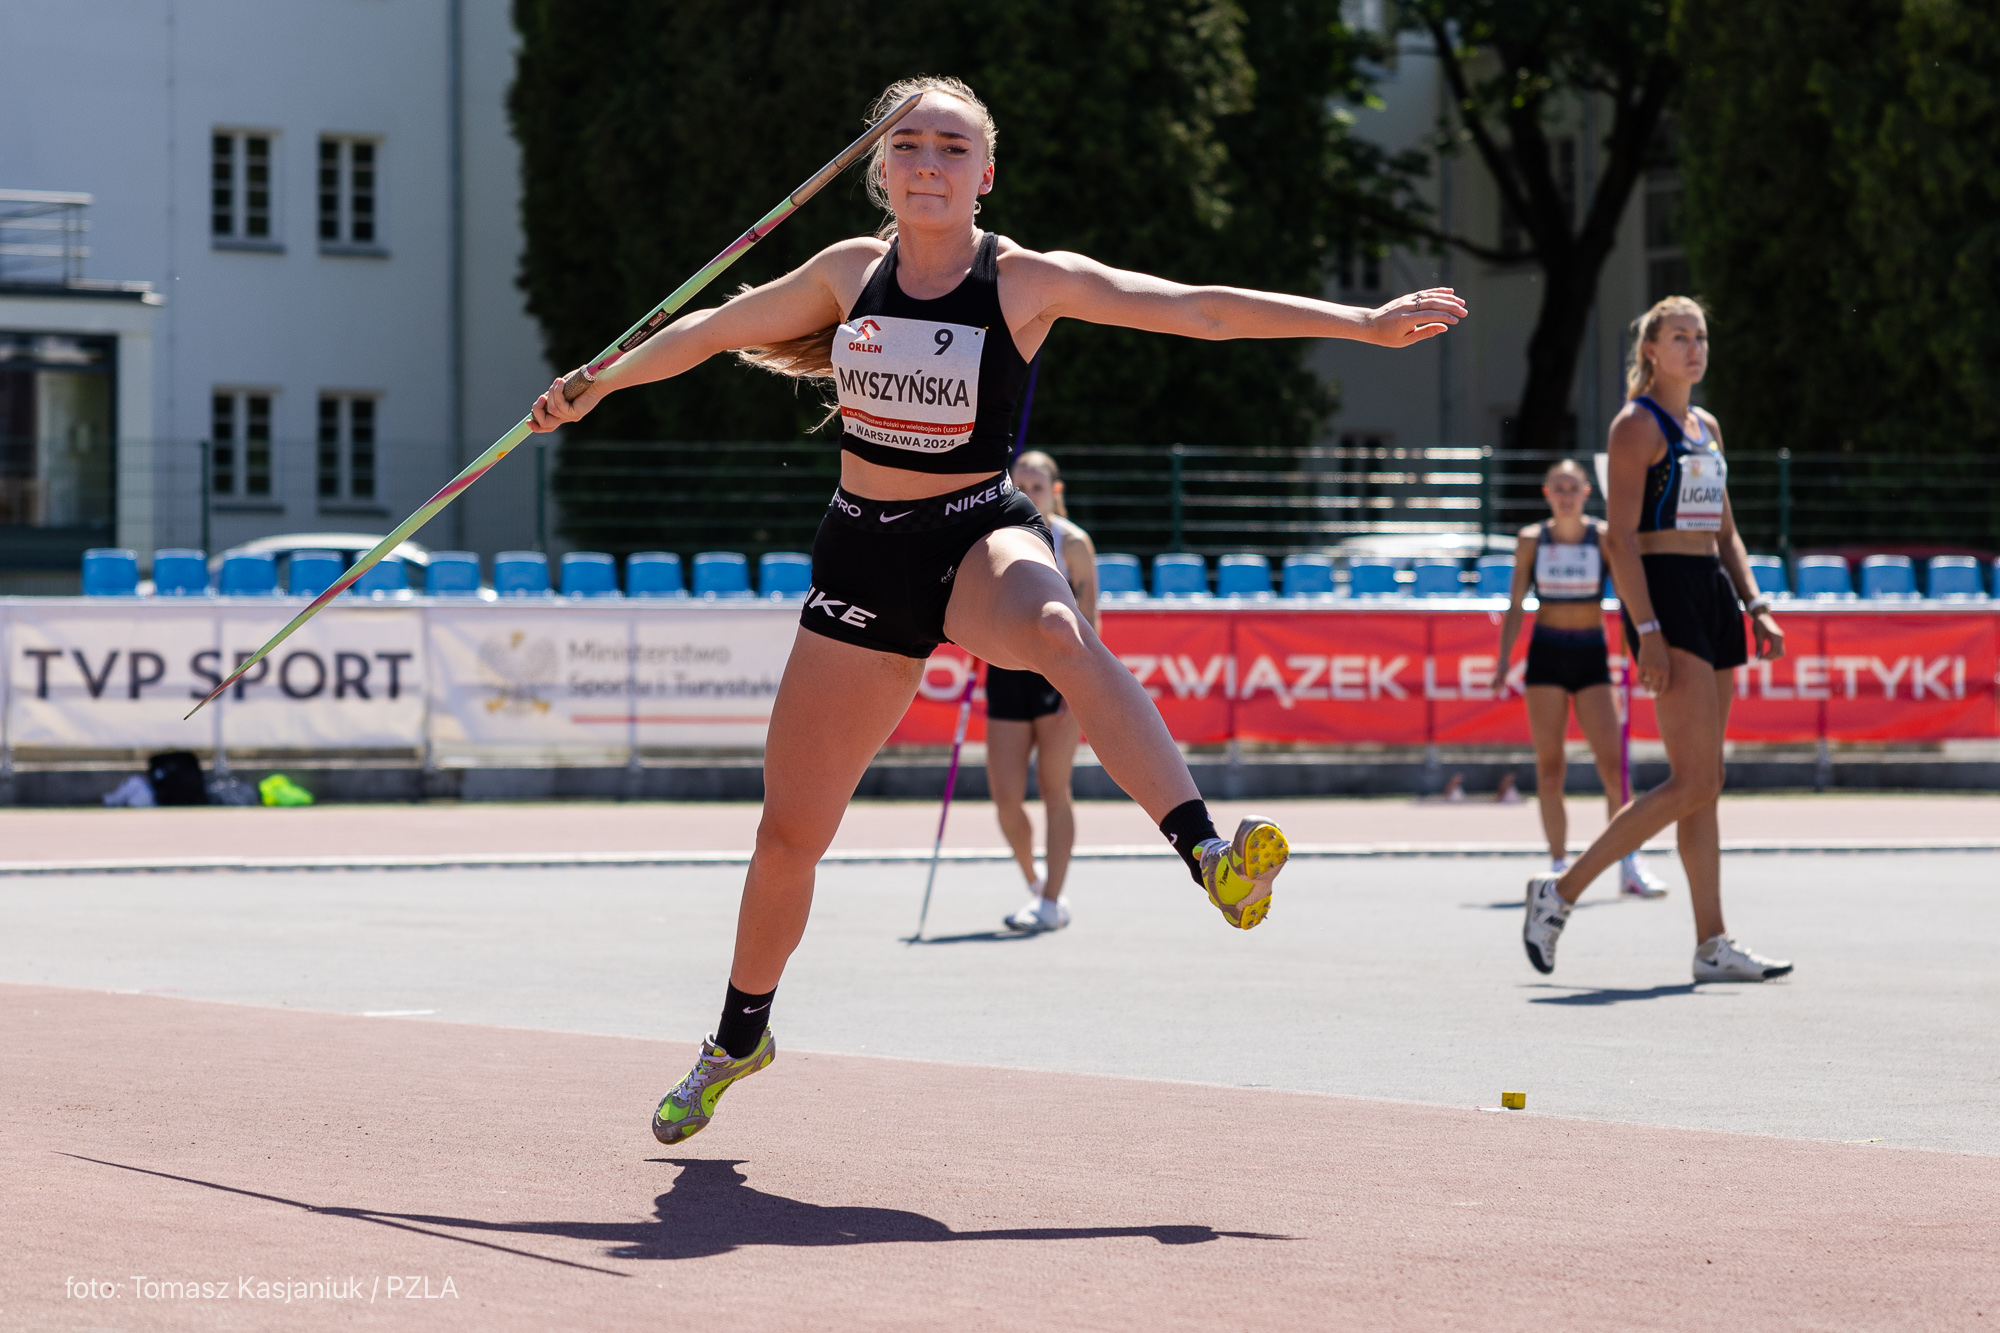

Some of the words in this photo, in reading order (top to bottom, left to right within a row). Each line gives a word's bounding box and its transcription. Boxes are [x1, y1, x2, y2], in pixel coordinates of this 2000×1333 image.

[848, 341, 883, 354] ORLEN
[934, 328, 954, 356] 9
[838, 367, 970, 408] MYSZYŃSKA
[856, 423, 921, 448] WARSZAWA
[923, 438, 956, 449] 2024
[883, 420, 900, 428] Polski
[944, 485, 998, 516] NIKE
[804, 583, 878, 629] IKE
[567, 640, 732, 665] Ministerstwo
[23, 649, 167, 701] TVP
[189, 649, 413, 701] SPORT
[1117, 654, 1409, 709] ZWIĄZEK
[1737, 655, 1967, 700] TLETYKI
